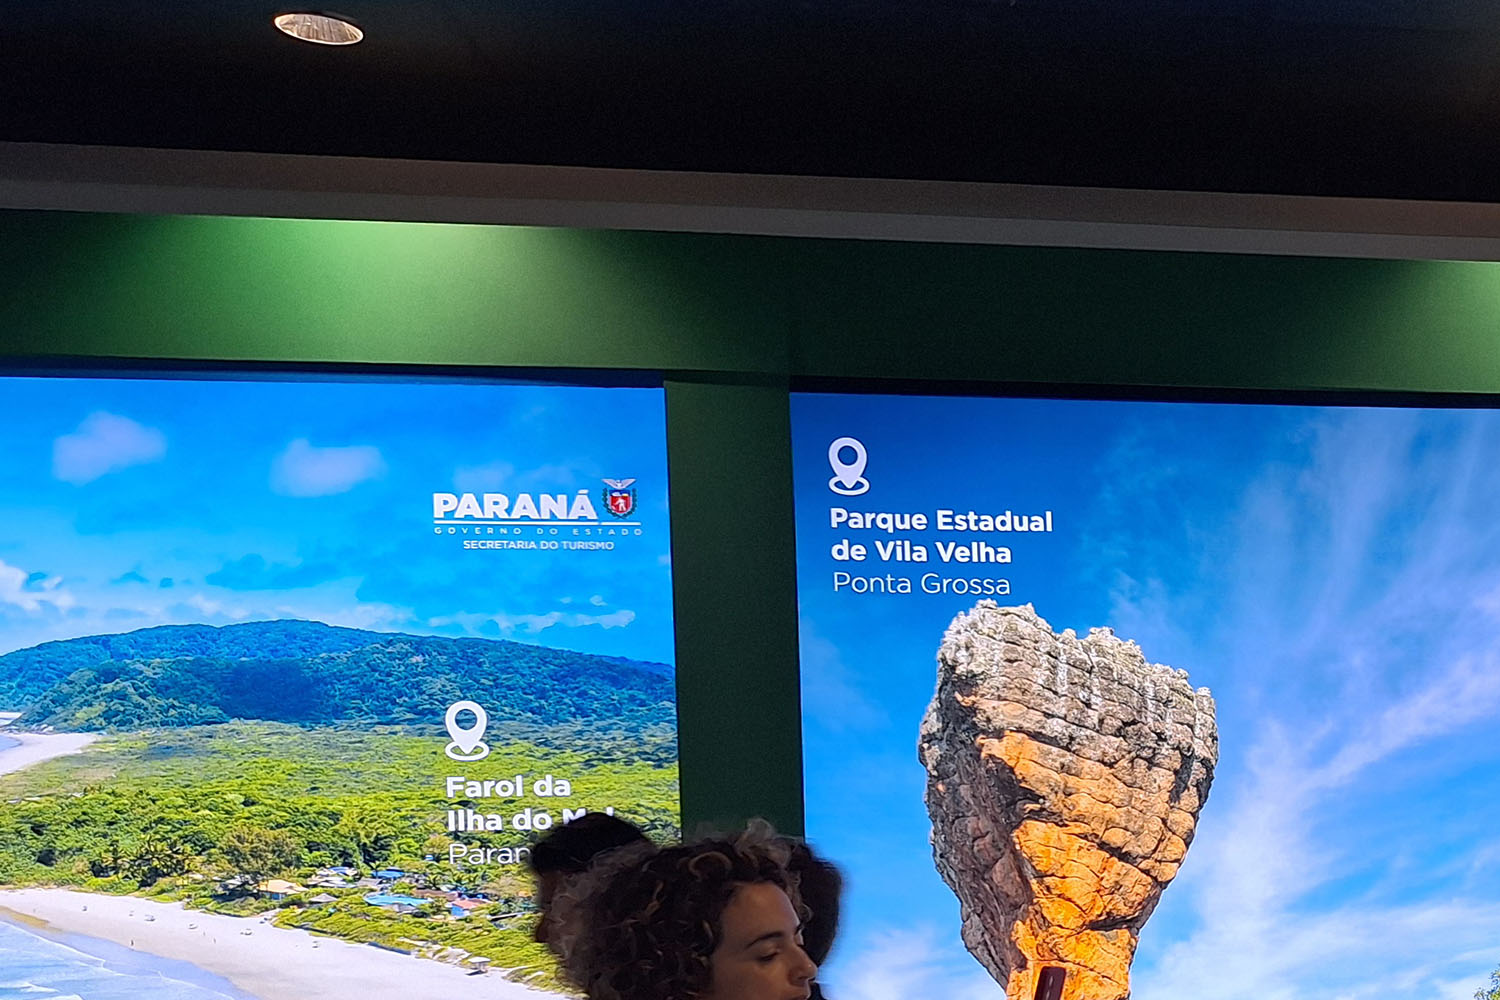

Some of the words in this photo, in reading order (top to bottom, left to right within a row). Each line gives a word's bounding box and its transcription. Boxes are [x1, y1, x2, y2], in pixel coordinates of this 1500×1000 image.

[433, 489, 598, 519] PARANÁ
[434, 527, 522, 535] GOVERNO
[573, 528, 643, 536] ESTADO
[830, 507, 928, 533] Parque
[936, 509, 1053, 532] Estadual
[463, 540, 537, 550] SECRETARIA
[540, 541, 559, 550] DO
[563, 541, 614, 550] TURISMO
[831, 539, 867, 561] de
[874, 540, 928, 562] Vila
[935, 541, 1012, 563] Velha
[833, 571, 911, 594] Ponta
[921, 573, 1011, 595] Grossa
[446, 775, 524, 798] Farol
[533, 775, 571, 797] da
[448, 808, 503, 831] Ilha
[513, 808, 552, 830] do
[448, 843, 532, 865] Paran
